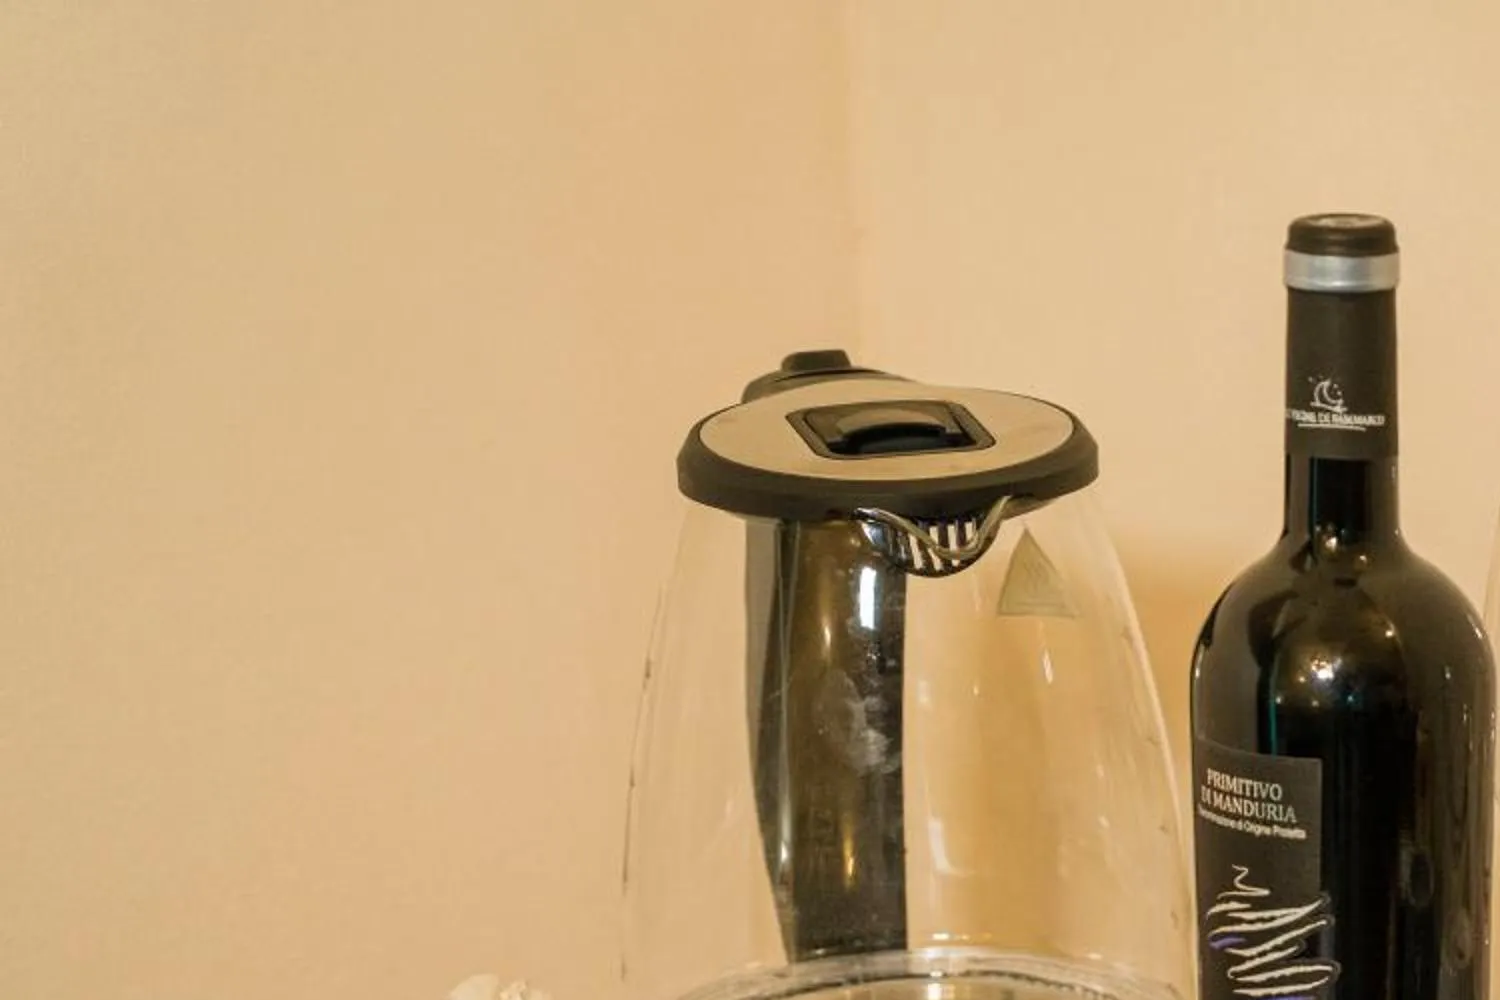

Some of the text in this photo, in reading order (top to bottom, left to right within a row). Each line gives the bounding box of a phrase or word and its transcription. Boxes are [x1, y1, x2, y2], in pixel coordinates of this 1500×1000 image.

[1206, 768, 1283, 801] PRIMITIVO
[1201, 785, 1212, 805] DI
[1212, 790, 1297, 824] MANDURIA
